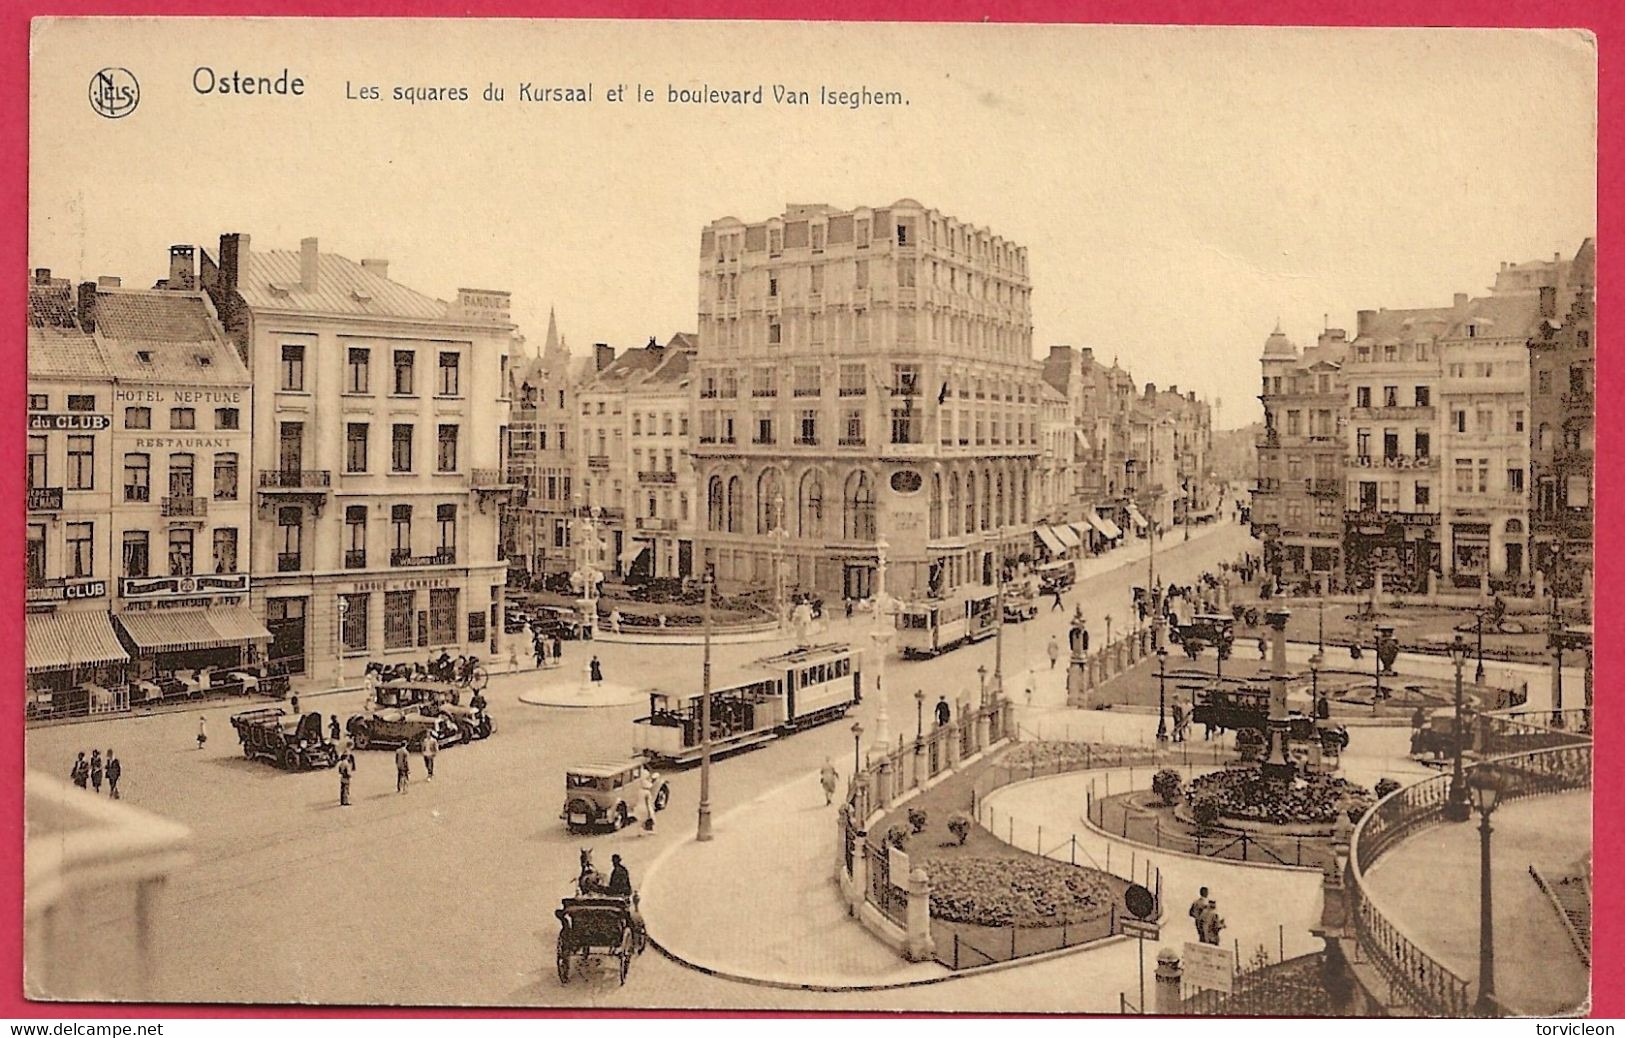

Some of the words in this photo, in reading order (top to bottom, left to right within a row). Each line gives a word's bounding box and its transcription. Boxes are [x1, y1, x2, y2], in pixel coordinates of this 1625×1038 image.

[115, 390, 164, 402] HOTEL
[174, 391, 241, 403] NEPTUNE
[32, 413, 51, 428] du
[56, 416, 104, 429] CLUB
[136, 438, 232, 448] RESTAURANT
[66, 582, 105, 598] CLUB
[353, 582, 387, 592] BANQUE
[403, 579, 450, 589] COMMERCE
